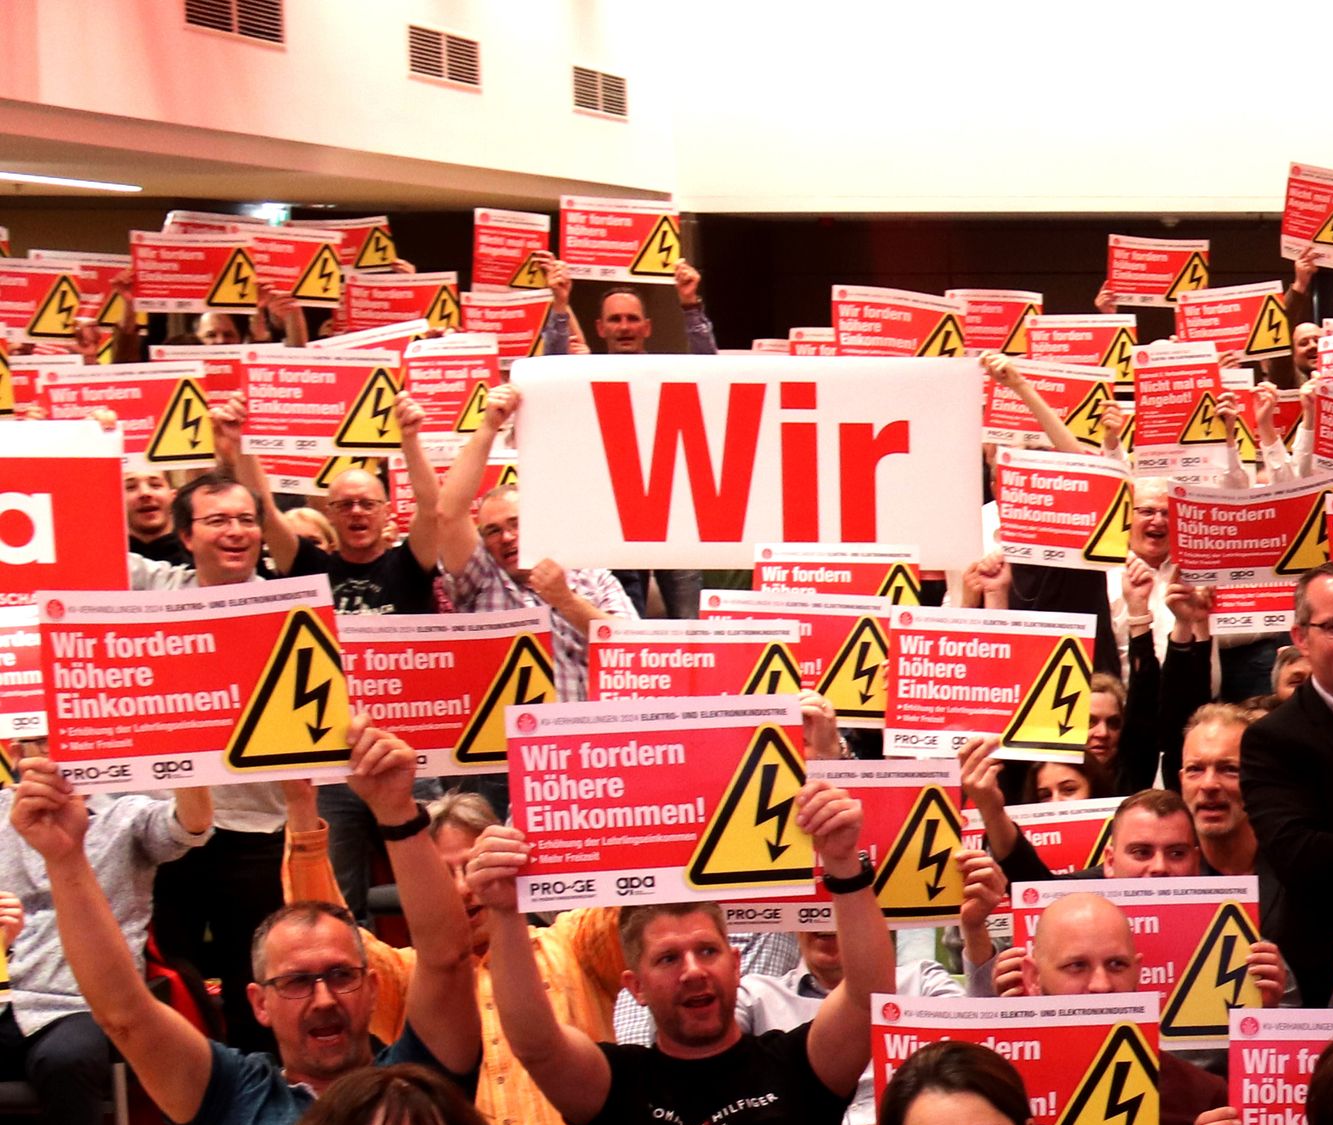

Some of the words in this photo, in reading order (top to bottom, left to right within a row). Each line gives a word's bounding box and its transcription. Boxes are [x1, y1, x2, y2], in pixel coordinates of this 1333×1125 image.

[248, 368, 275, 382] Wir
[279, 368, 336, 384] fordern
[1139, 380, 1170, 393] Nicht
[1173, 378, 1194, 390] mal
[1197, 376, 1214, 388] ein
[249, 384, 303, 399] höhere
[1140, 391, 1192, 407] Angebot!
[249, 399, 345, 415] Einkommen!
[590, 381, 910, 543] Wir
[1002, 470, 1027, 489] Wir
[1031, 472, 1089, 492] fordern
[1001, 488, 1054, 507] höhere
[1001, 507, 1096, 526] Einkommen!
[1177, 503, 1206, 519] Wir
[1211, 504, 1276, 522] fordern
[1177, 520, 1238, 536] höhere
[1178, 534, 1287, 549] Einkommen!
[51, 632, 98, 658] Wir
[105, 631, 215, 657] fordern
[900, 636, 934, 656] Wir
[939, 637, 1010, 659] fordern
[53, 662, 152, 689] höhere
[899, 658, 966, 678] höhere
[57, 684, 240, 719] Einkommen!
[898, 680, 1020, 703] Einkommen!
[640, 711, 677, 722] ELEKTRO-
[681, 710, 697, 720] UND
[700, 706, 788, 719] ELEKTRONIKINDUSTRIE
[521, 745, 571, 772] Wir
[579, 741, 685, 768] fordern
[62, 766, 131, 780] PRO-GE
[152, 759, 193, 780] gpa
[525, 775, 624, 802] höhere
[527, 797, 705, 832] Einkommen!
[538, 853, 562, 864] Mehr
[565, 851, 600, 864] Freizeit
[530, 878, 596, 897] PRO-GE
[616, 875, 656, 896] gpa
